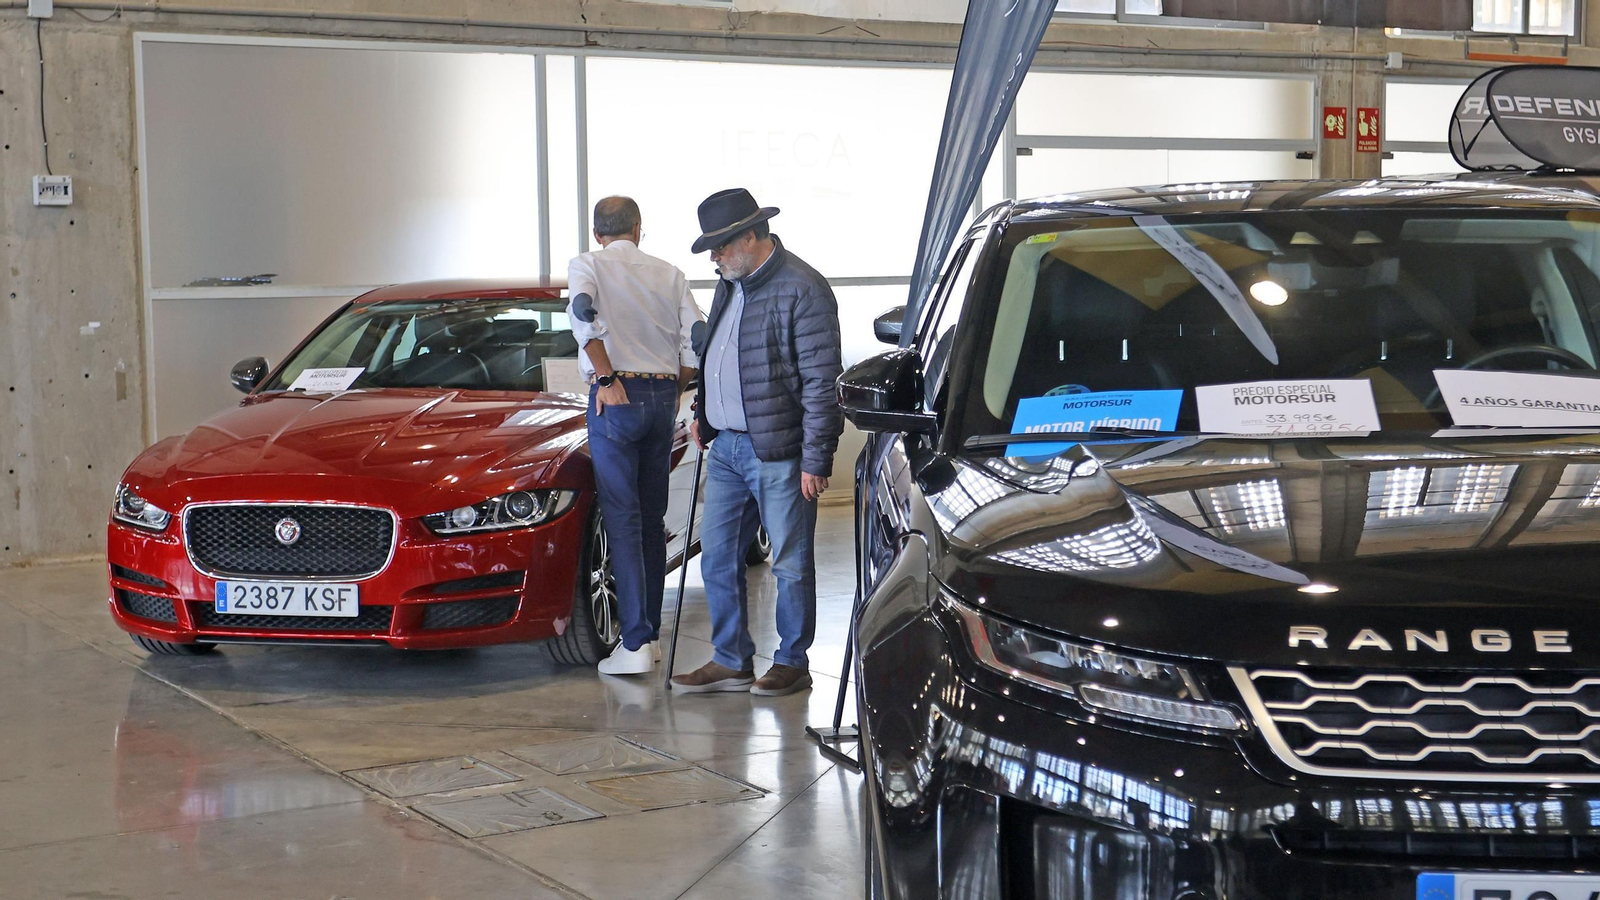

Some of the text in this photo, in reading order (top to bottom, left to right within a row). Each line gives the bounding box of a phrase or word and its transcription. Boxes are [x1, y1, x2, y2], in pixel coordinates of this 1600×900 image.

[1492, 95, 1600, 117] DEFEN
[1562, 126, 1600, 145] GYS
[721, 129, 852, 168] IFECA
[1232, 384, 1335, 397] PRECIO ESPECIAL
[1062, 398, 1133, 410] MOTORSUR
[1234, 394, 1337, 406] MOTORSUR
[1473, 396, 1518, 407] AÑOS
[1024, 416, 1162, 434] MOTOR HÍBRIDO
[233, 585, 352, 612] 2387 KSF
[1288, 625, 1573, 652] RANGE
